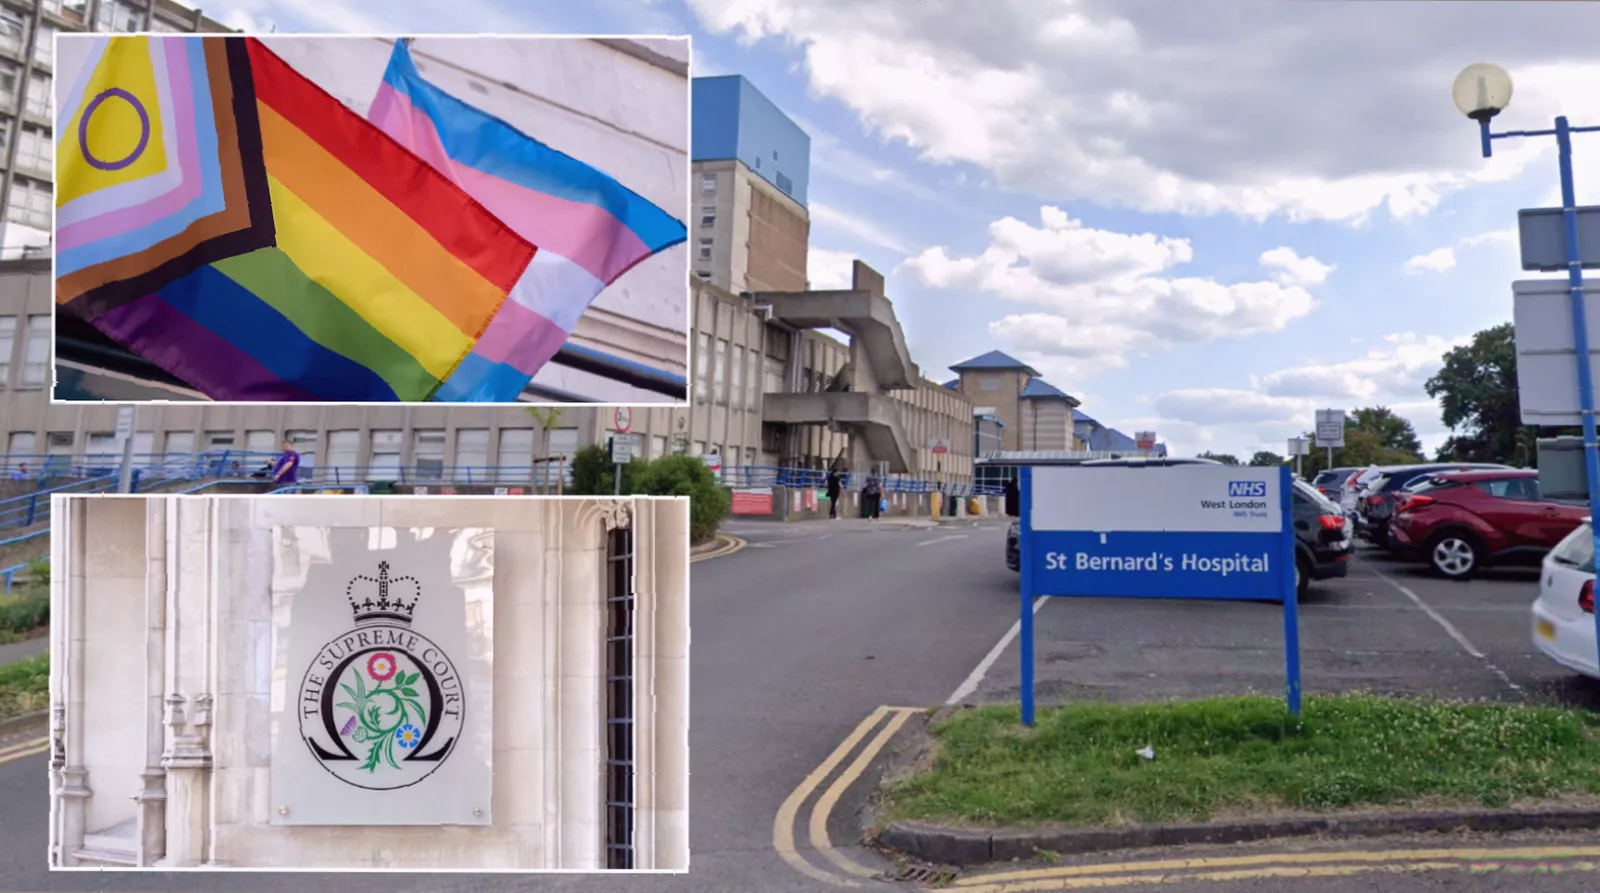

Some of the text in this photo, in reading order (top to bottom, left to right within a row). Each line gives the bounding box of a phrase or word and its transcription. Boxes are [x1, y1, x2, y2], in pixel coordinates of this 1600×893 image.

[1230, 482, 1264, 496] NHS
[1201, 500, 1266, 509] West London
[1046, 552, 1269, 576] St Bernard's Hospital
[304, 629, 460, 720] THE SUPREME COURT
